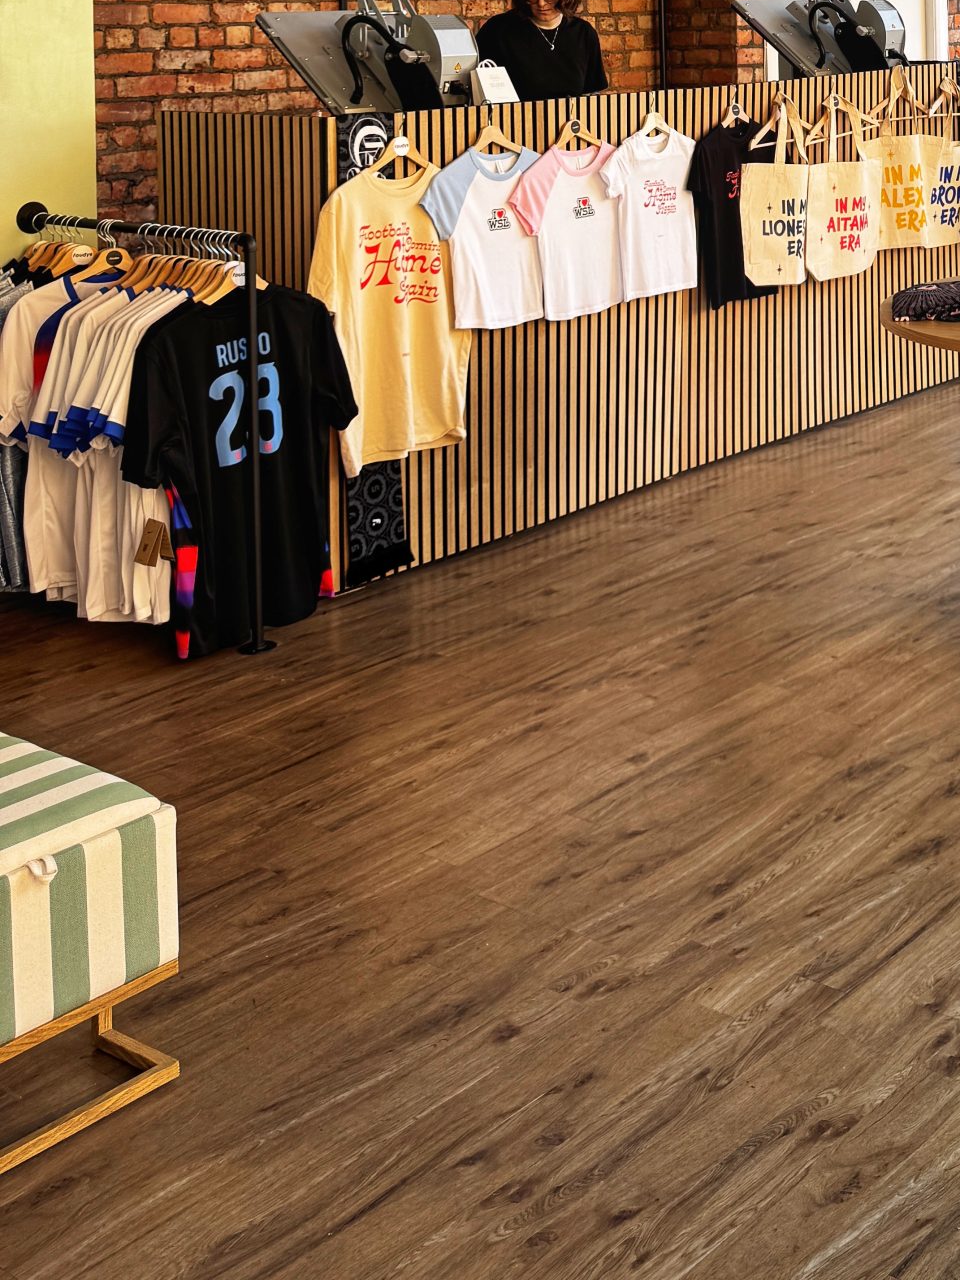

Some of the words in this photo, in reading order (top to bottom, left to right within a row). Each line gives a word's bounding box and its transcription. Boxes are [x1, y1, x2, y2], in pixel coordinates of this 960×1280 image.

[884, 164, 902, 185] IN
[910, 163, 922, 182] M
[940, 166, 954, 184] IN
[574, 206, 594, 216] WSL
[782, 198, 795, 216] IN
[835, 197, 848, 214] IN
[488, 219, 510, 228] WSL
[826, 213, 868, 232] AITANA
[896, 209, 928, 232] ERA
[940, 207, 960, 227] ERA
[840, 234, 860, 252] ERA
[216, 332, 270, 368] RUSO
[209, 362, 284, 468] 23
